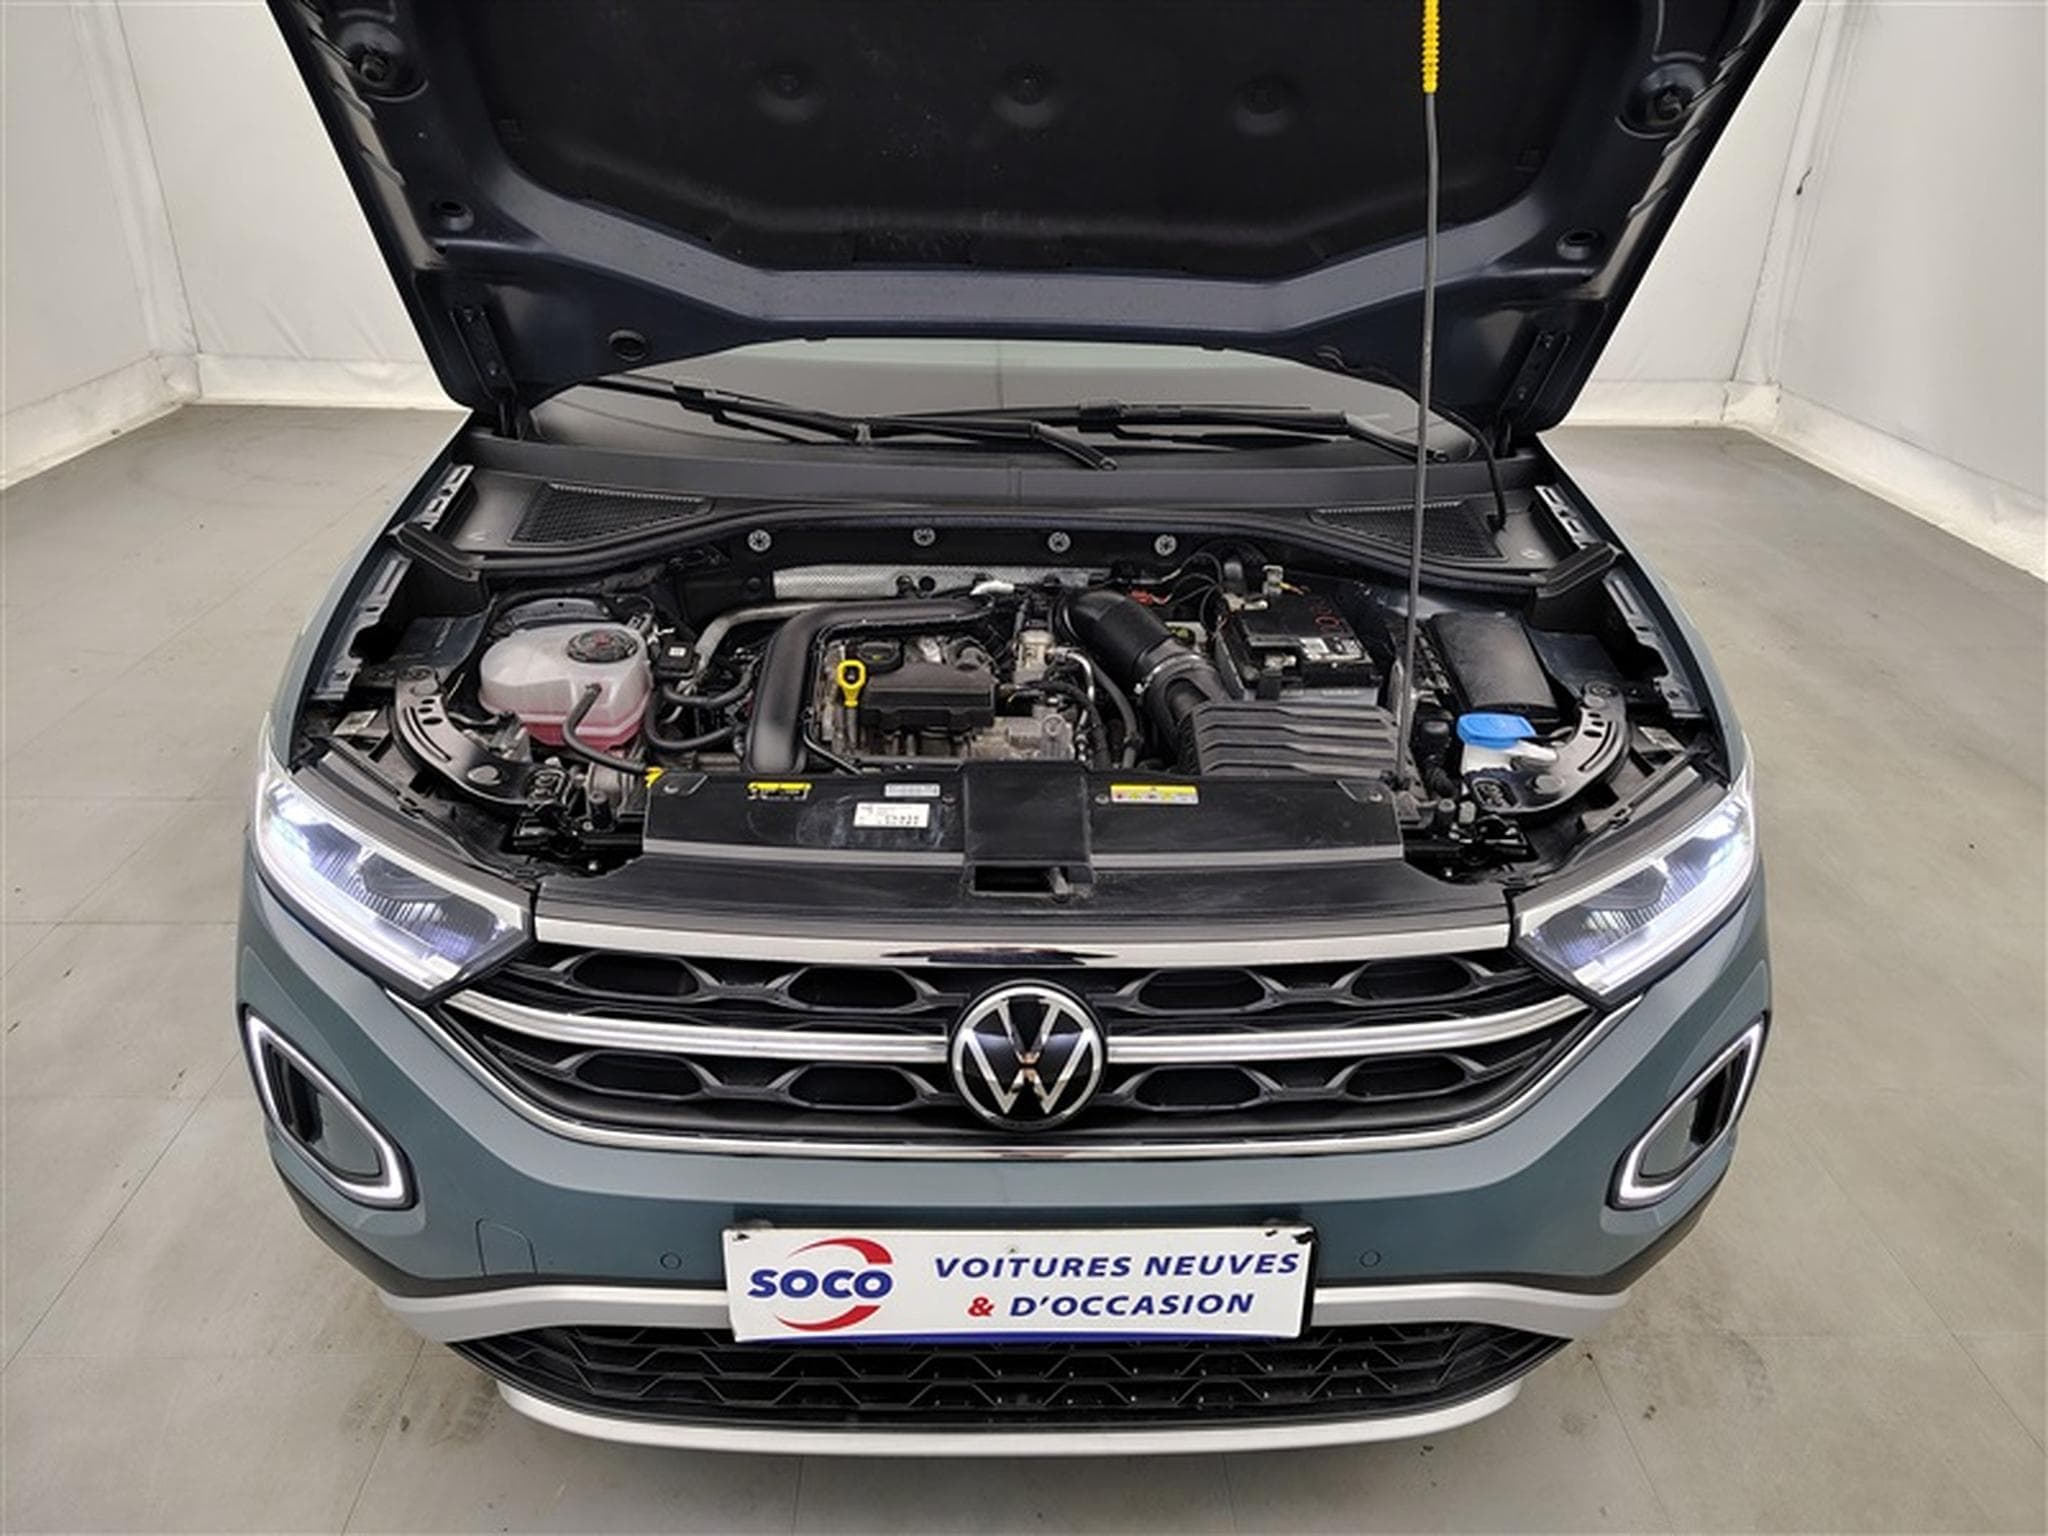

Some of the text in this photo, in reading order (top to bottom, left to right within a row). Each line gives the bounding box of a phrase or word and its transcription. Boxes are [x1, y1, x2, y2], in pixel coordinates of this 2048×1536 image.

[935, 1253, 1300, 1278] VOITURES NEUVES
[747, 1269, 893, 1299] SOCO
[967, 1294, 1254, 1317] & D'OCCASION
